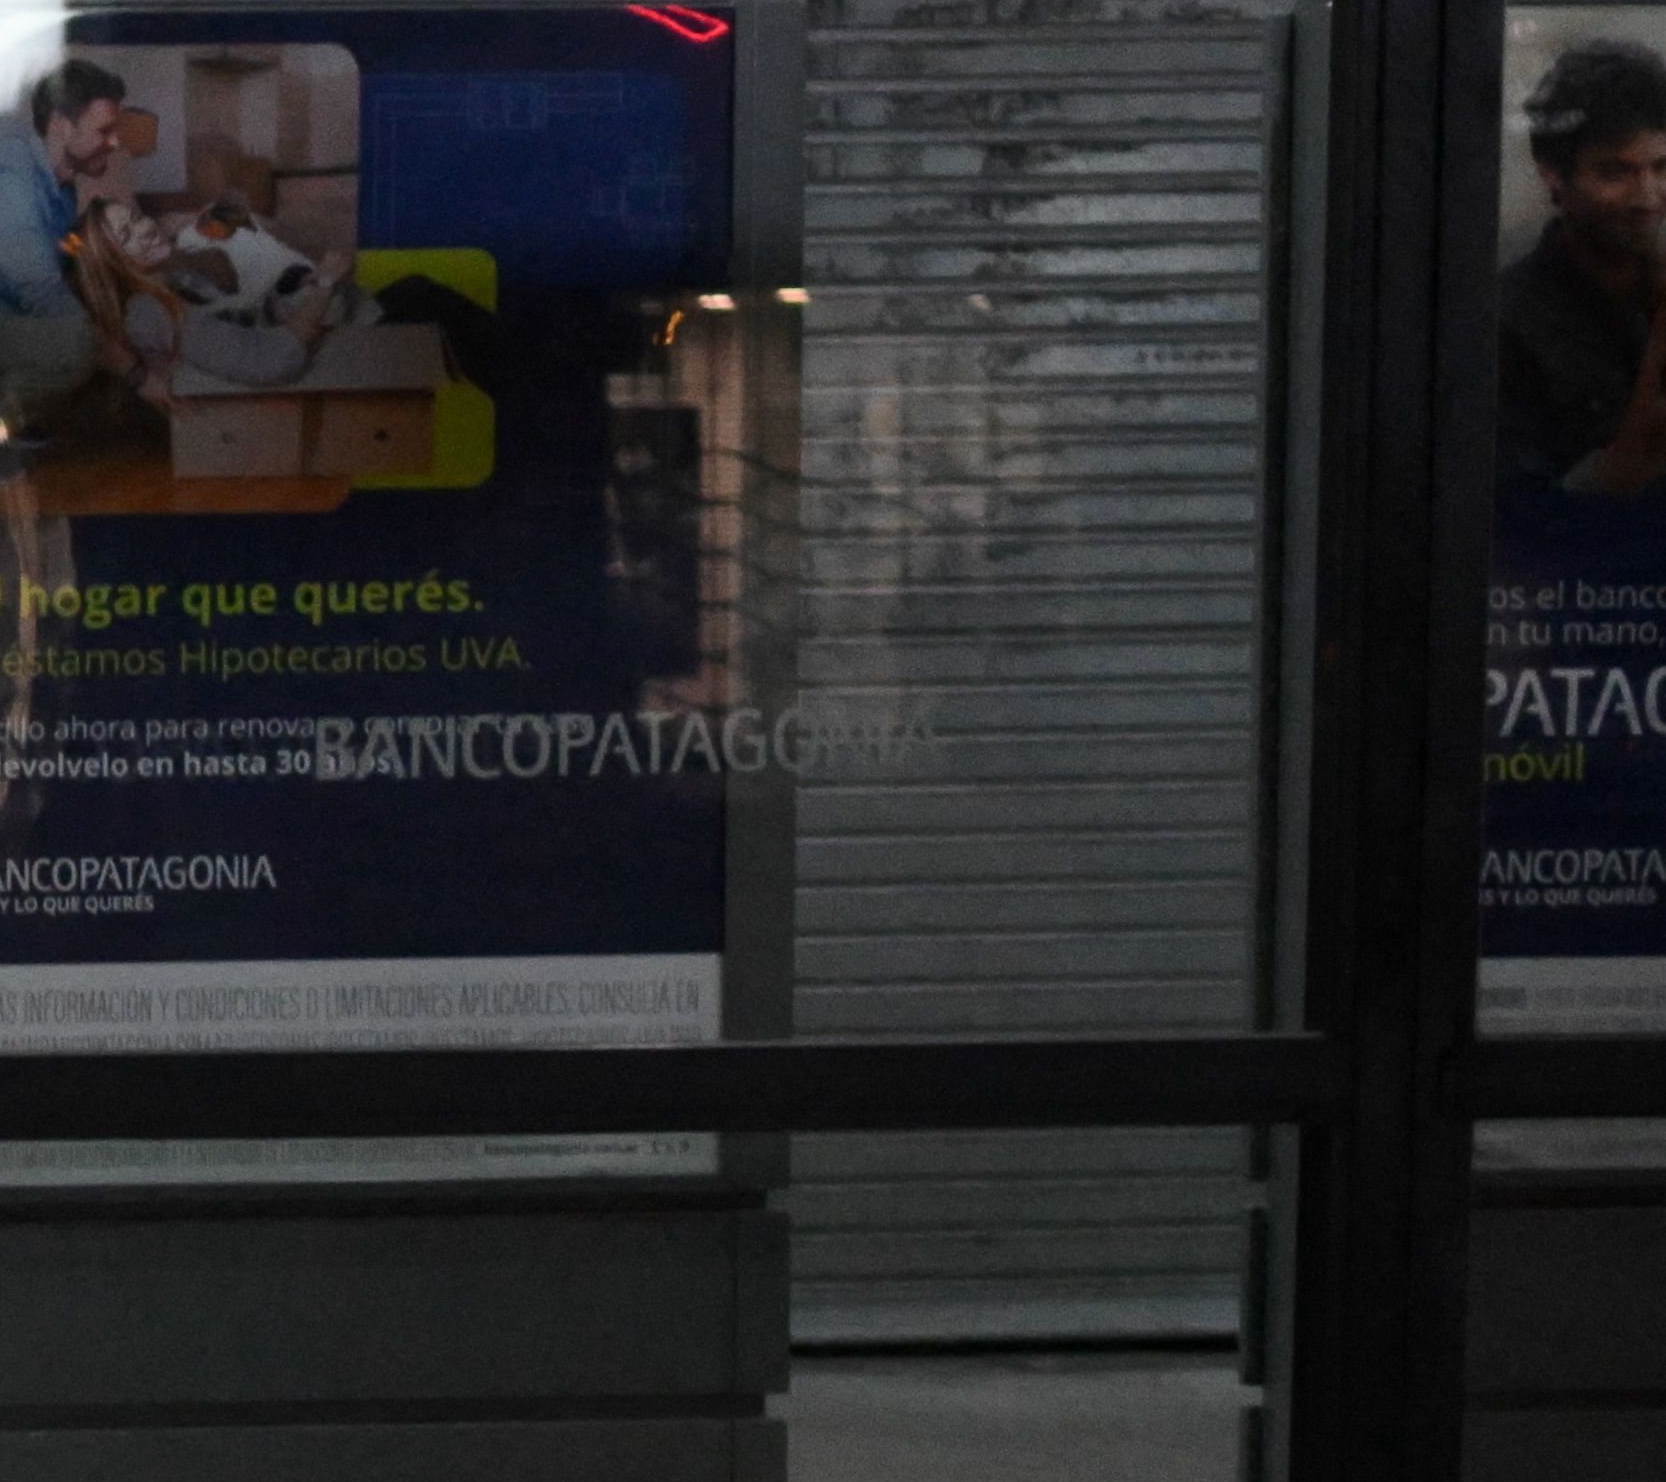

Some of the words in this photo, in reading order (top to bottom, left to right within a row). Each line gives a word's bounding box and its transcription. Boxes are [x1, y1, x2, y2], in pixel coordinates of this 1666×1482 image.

[20, 573, 168, 629] hogar
[182, 580, 278, 629] que
[293, 569, 486, 628] querés.
[1486, 584, 1526, 610] os
[1536, 578, 1564, 610] el
[1518, 618, 1552, 646] tu
[180, 637, 427, 683] Hipotecarios
[440, 635, 533, 670] UVA.
[53, 714, 145, 742] ahora
[145, 717, 209, 747] para
[137, 756, 174, 779] en
[183, 750, 267, 777] hasta
[275, 748, 311, 776] 30
[1483, 847, 1666, 886] ANCOPATA
[14, 895, 39, 914] LO
[42, 894, 80, 916] QUE
[84, 891, 155, 914] QUERÉS
